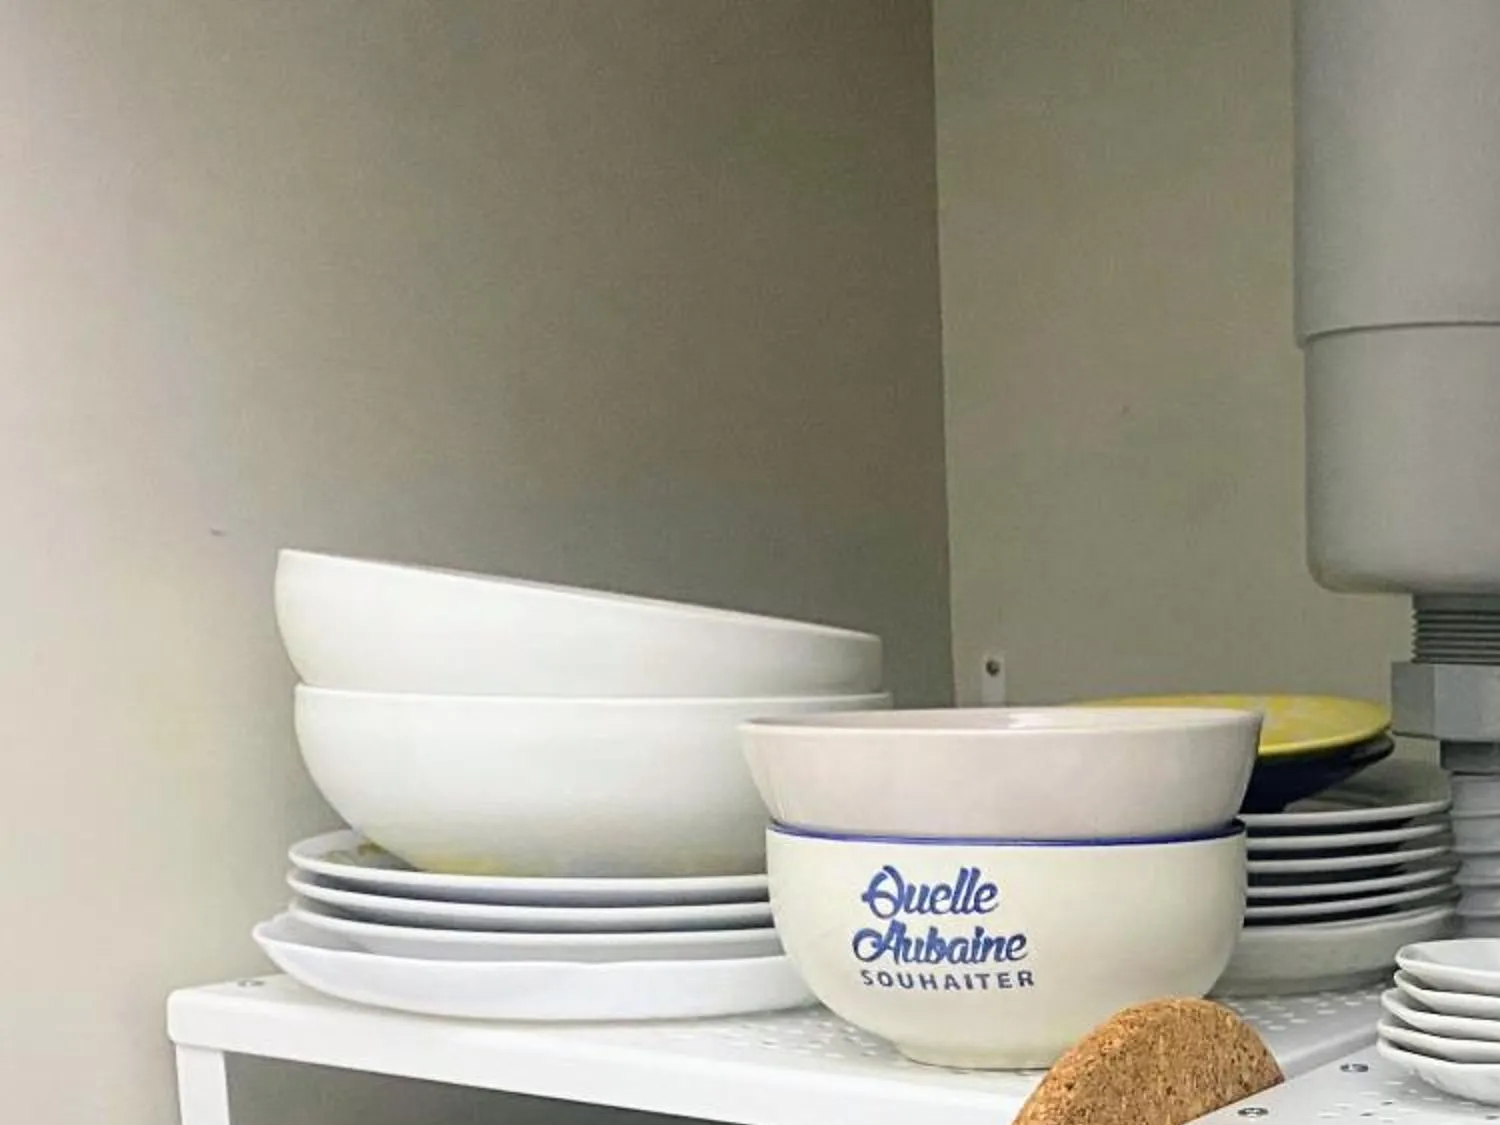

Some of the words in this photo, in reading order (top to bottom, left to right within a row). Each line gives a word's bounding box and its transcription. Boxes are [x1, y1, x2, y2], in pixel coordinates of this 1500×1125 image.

[861, 865, 999, 919] Quelle
[852, 918, 1028, 964] Aubaine
[861, 969, 1035, 991] SOUHAITER
